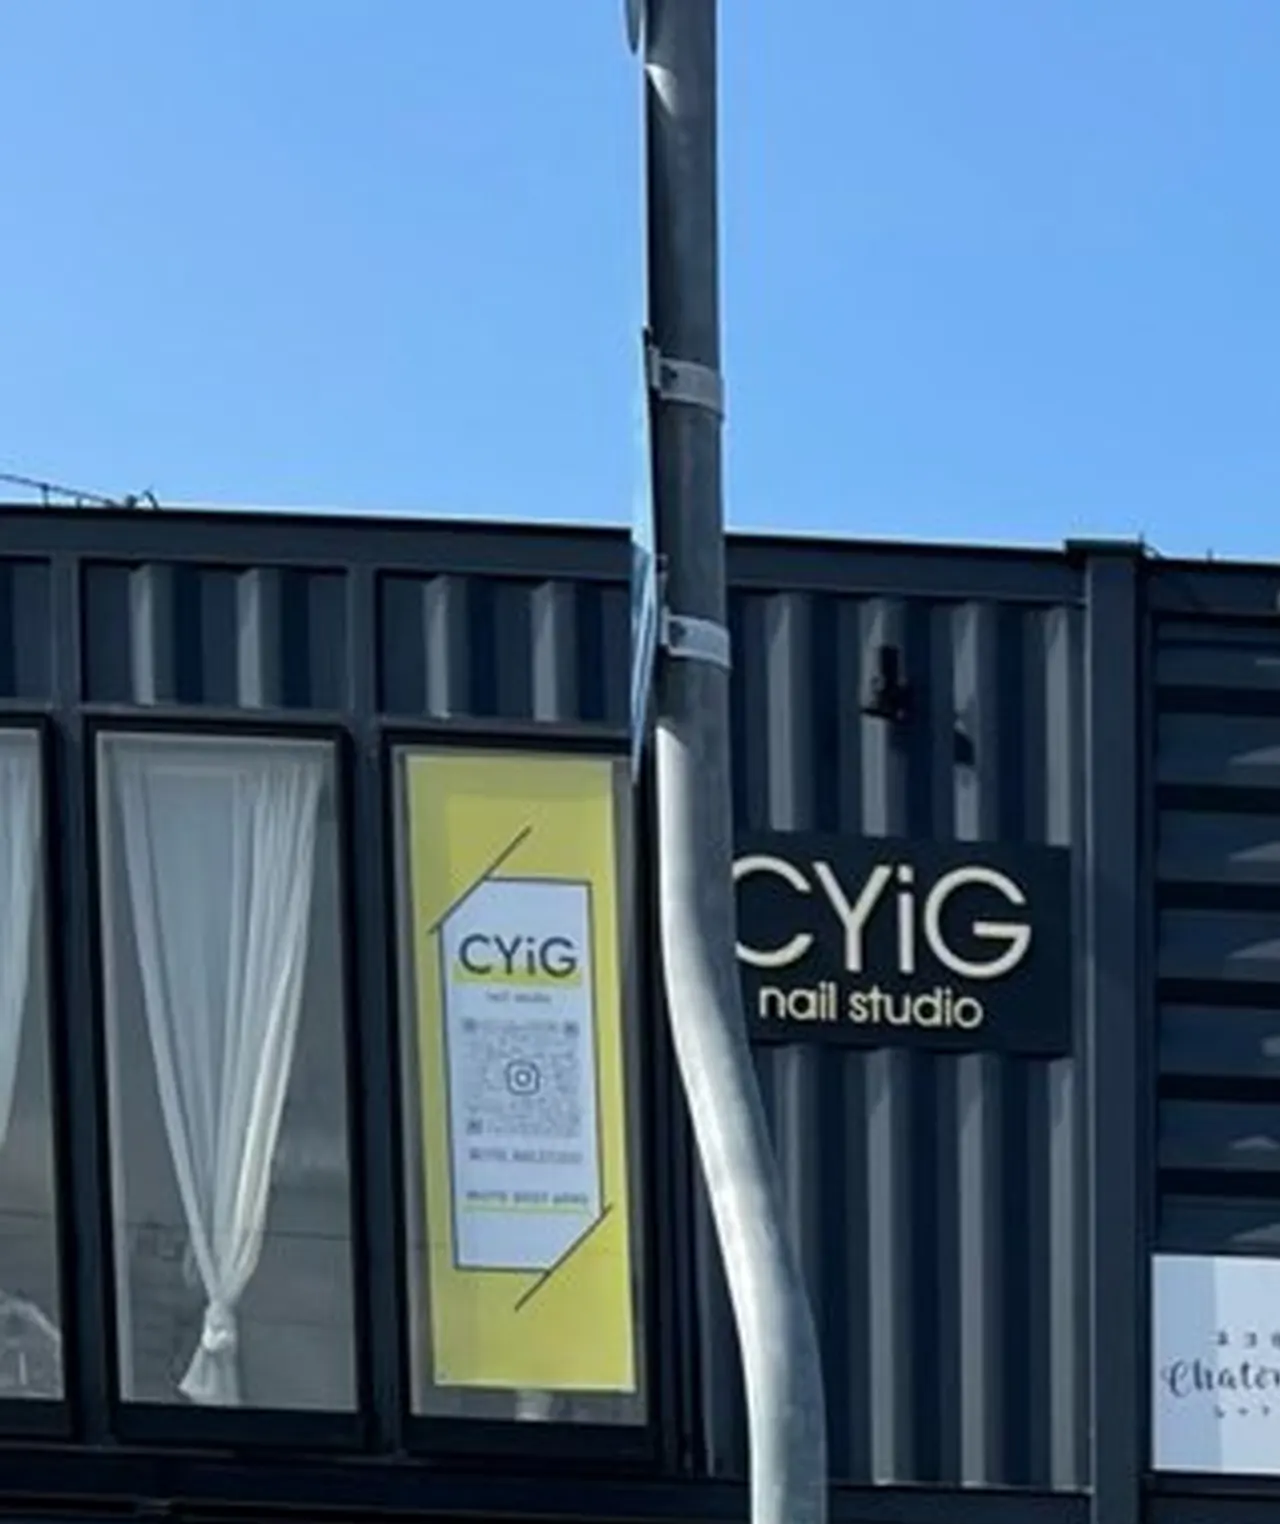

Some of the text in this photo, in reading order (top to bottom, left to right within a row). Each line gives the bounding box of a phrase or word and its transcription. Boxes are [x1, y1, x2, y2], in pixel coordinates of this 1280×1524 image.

[732, 855, 1032, 979] CYiG
[459, 933, 577, 978] CYiG
[759, 981, 984, 1029] nail studio
